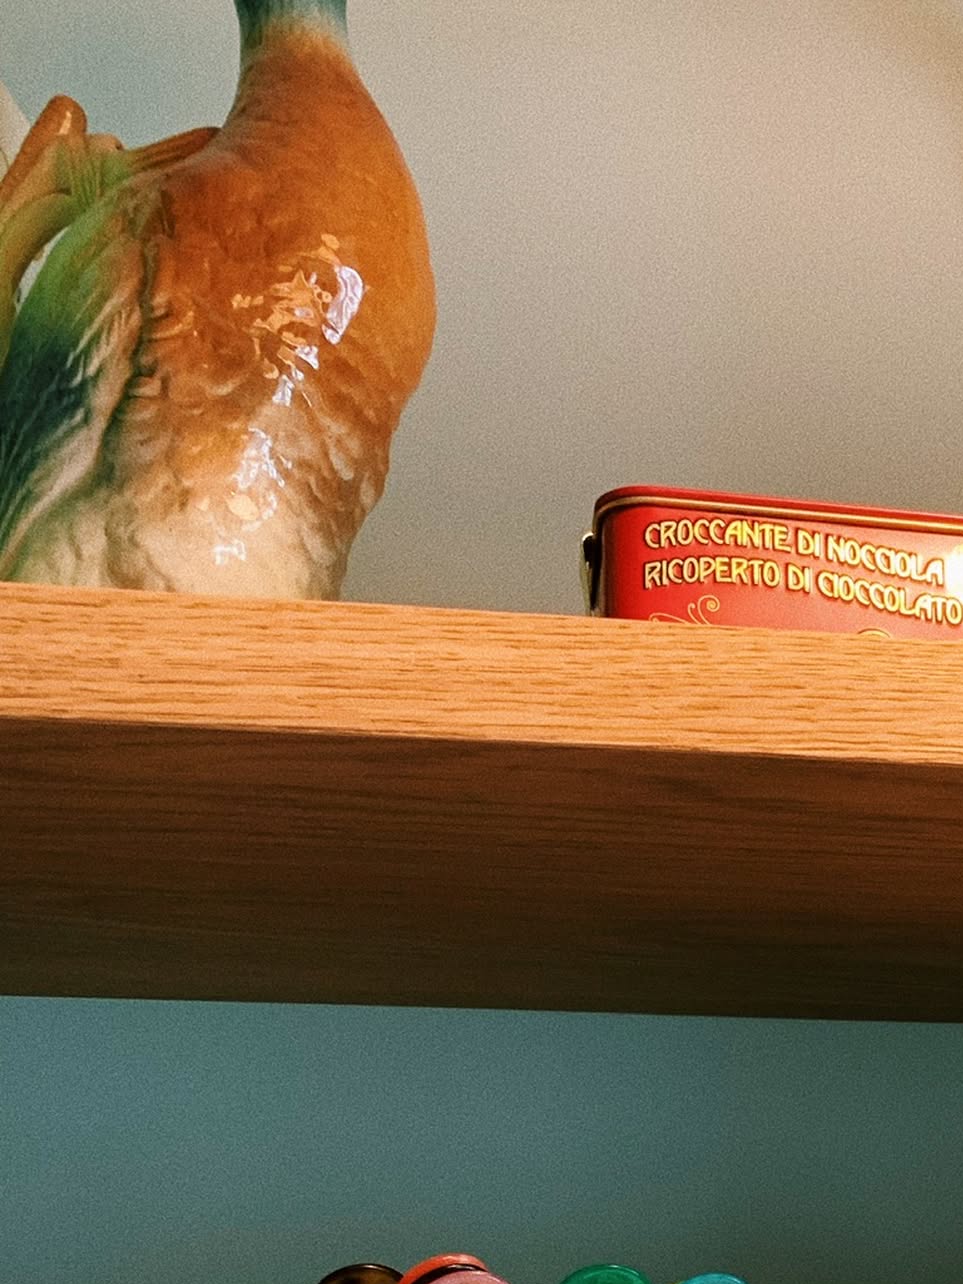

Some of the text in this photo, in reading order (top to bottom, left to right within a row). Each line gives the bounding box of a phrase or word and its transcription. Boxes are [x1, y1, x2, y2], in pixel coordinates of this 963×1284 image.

[644, 518, 793, 553] CROCCANTE
[796, 528, 822, 558] DI
[826, 534, 944, 586] NOCCIOLA
[644, 556, 781, 589] RICOPERTO
[787, 563, 812, 593] DI
[817, 570, 963, 626] CIOCCOLATO
